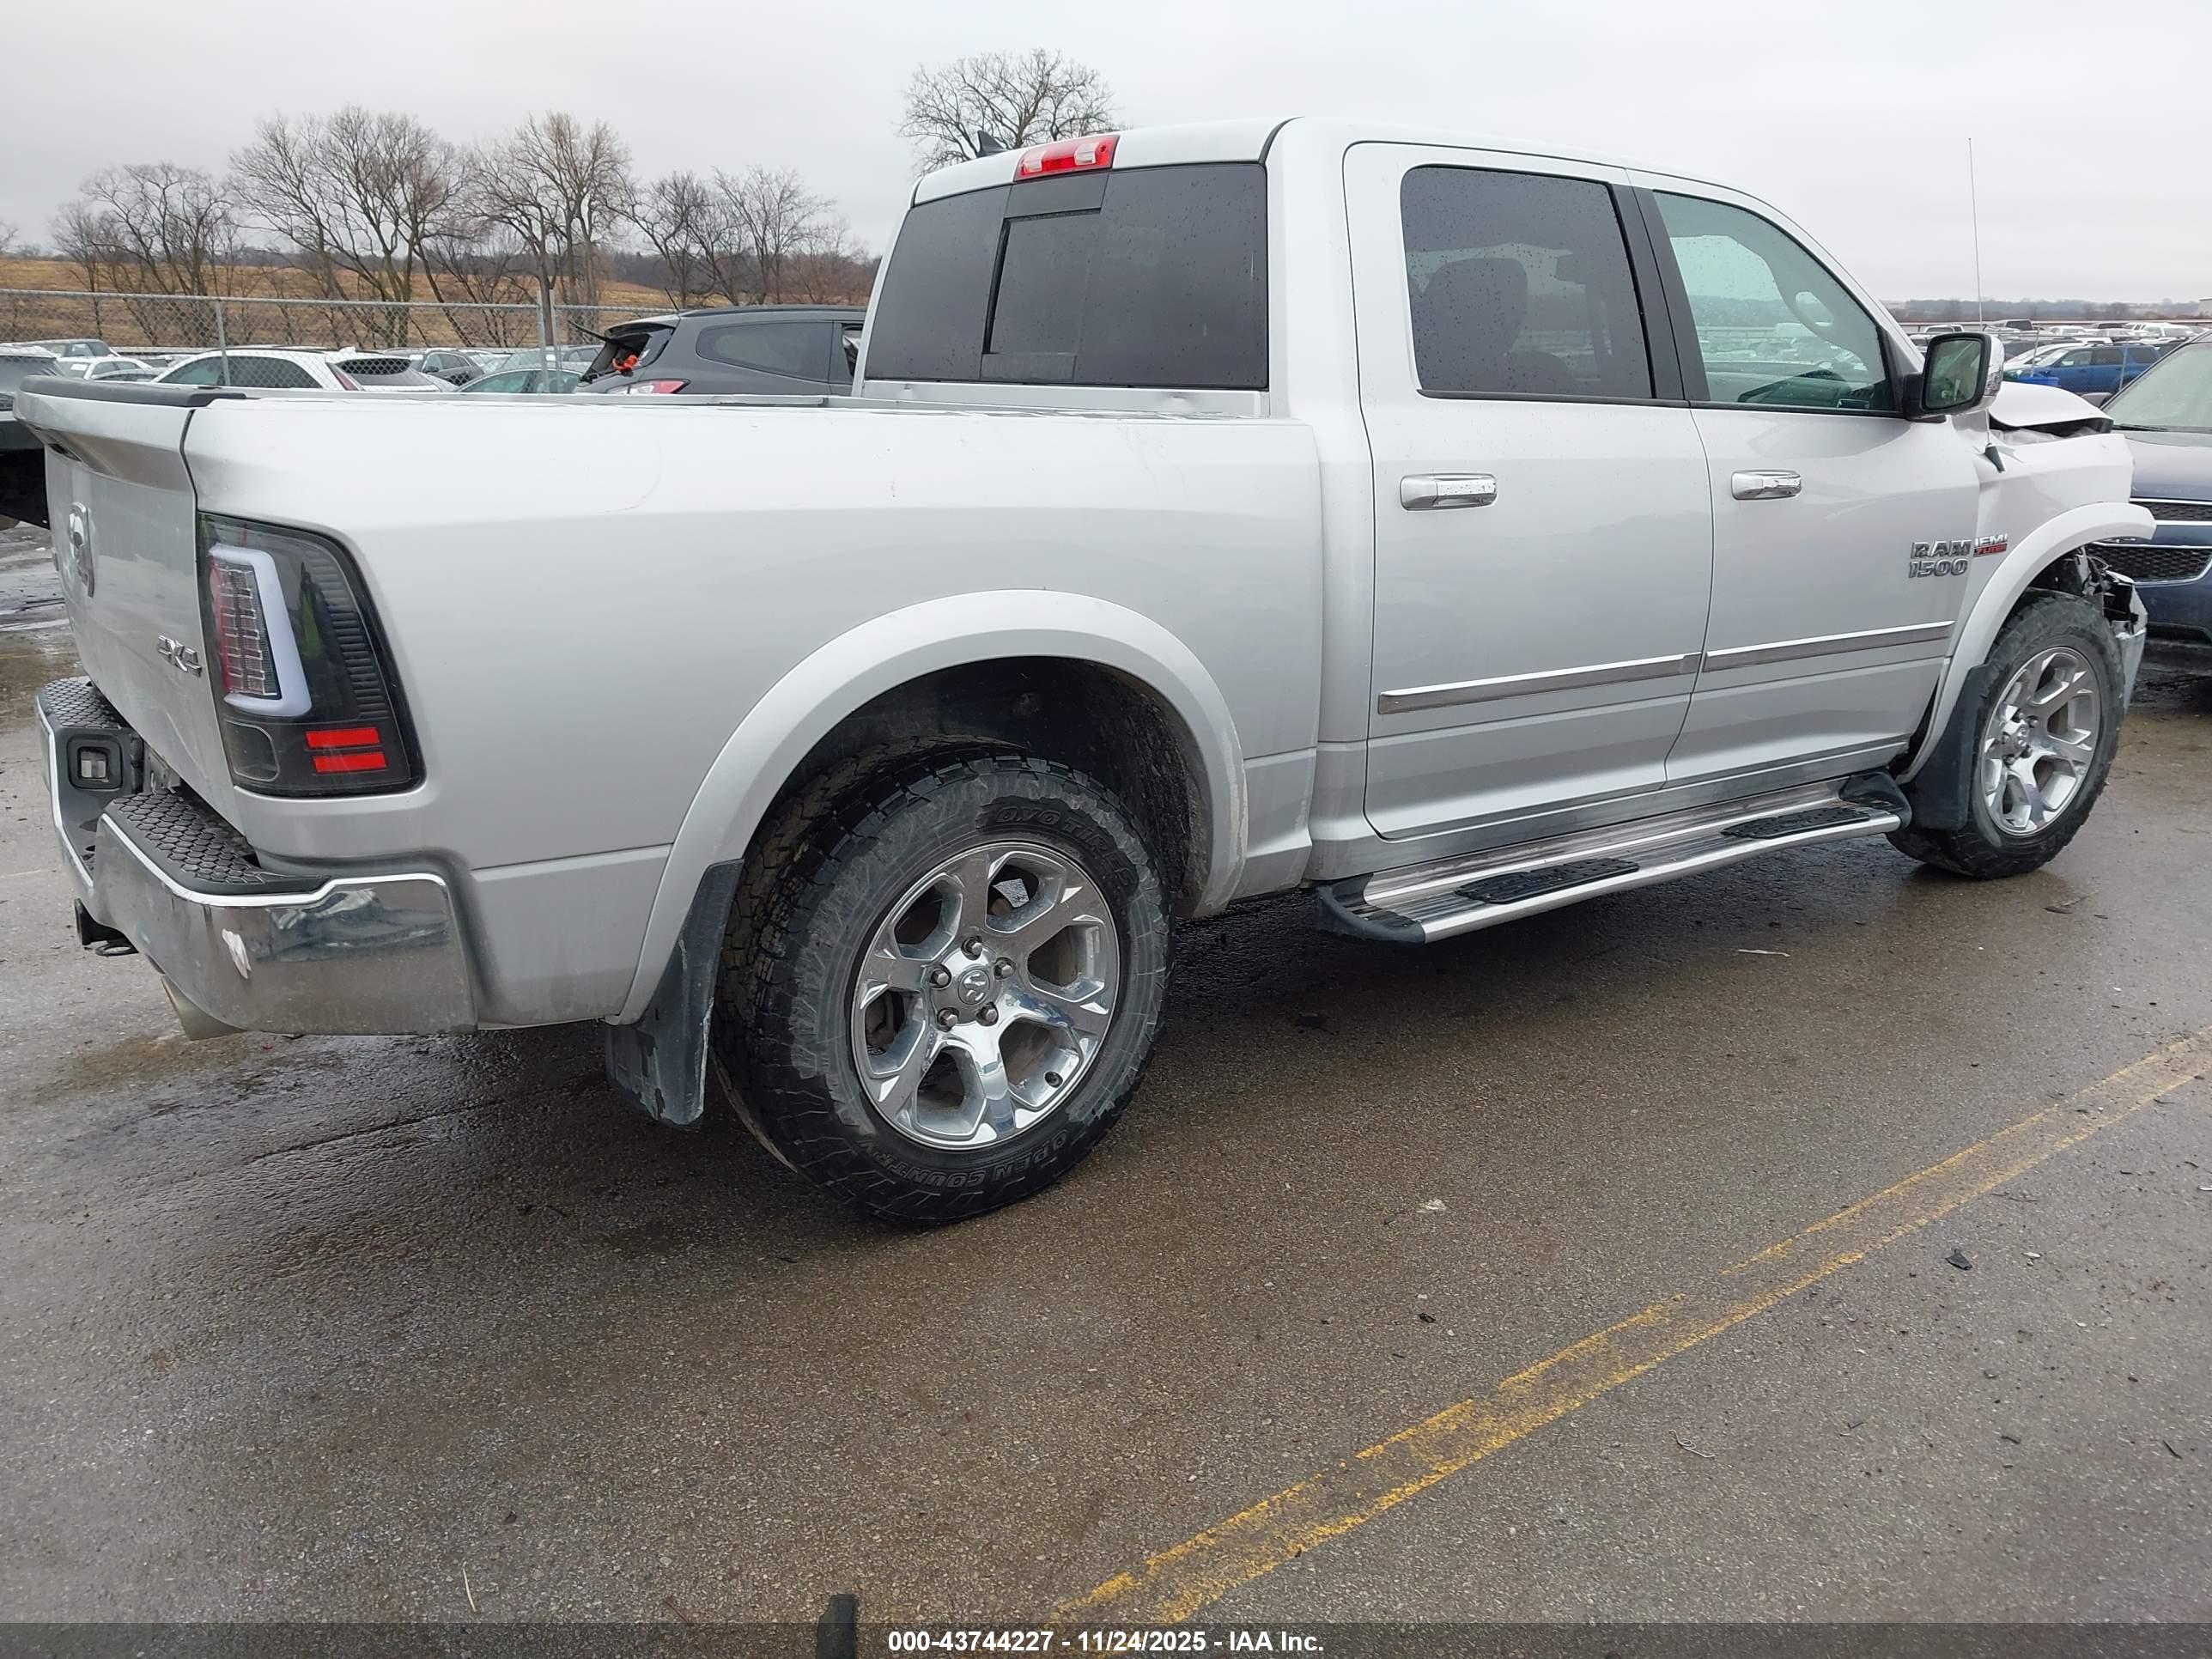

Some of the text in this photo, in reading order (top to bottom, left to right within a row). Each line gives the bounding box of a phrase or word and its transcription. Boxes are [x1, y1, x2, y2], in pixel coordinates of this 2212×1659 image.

[1911, 539, 1972, 559] RAM
[1909, 558, 1968, 578] 1500
[856, 1128, 1068, 1188] OPEN COUNTRY
